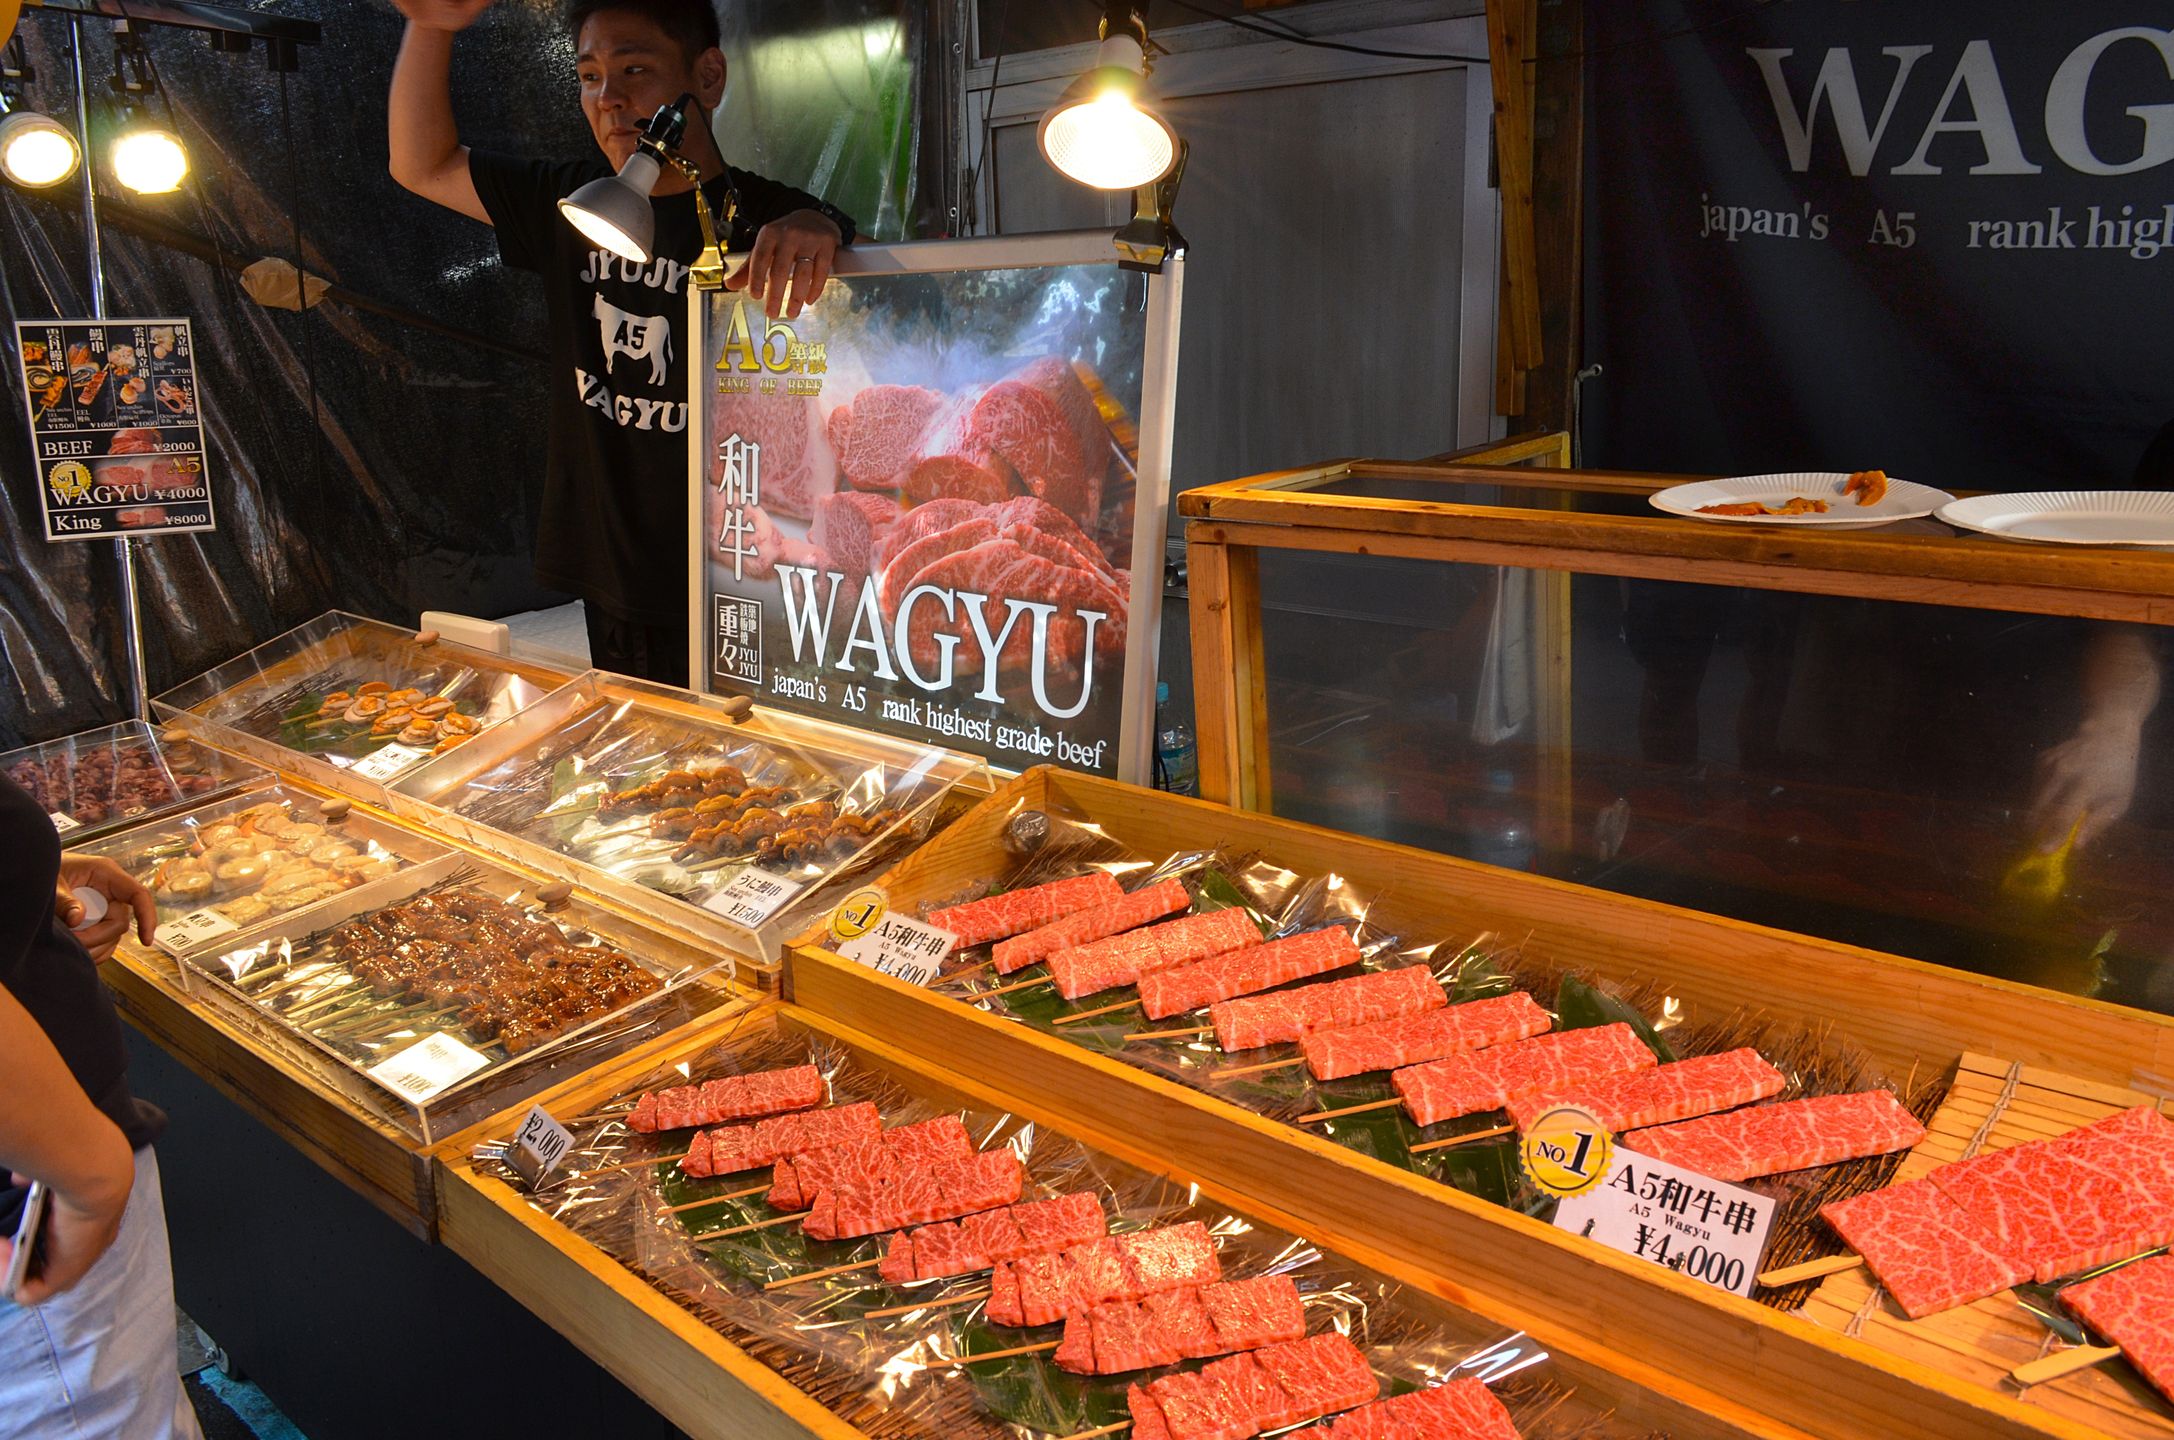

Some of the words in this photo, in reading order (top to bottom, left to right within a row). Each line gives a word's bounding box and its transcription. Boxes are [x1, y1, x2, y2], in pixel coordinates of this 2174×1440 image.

[1701, 193, 1829, 242] japan's
[1869, 208, 1916, 248] A5
[1967, 207, 2075, 250] rank
[614, 320, 648, 350] A5
[718, 377, 750, 394] KING
[760, 378, 777, 395] OF
[787, 379, 822, 396] BEEF
[44, 441, 93, 456] BEEF
[153, 442, 196, 453] ¥2000
[168, 457, 201, 474] A5
[51, 484, 150, 506] WAGYU
[154, 487, 206, 499] ¥4000
[718, 433, 760, 581] 和牛
[55, 515, 102, 531] King
[165, 514, 206, 525] ¥8000
[719, 604, 738, 671] 重々
[773, 564, 1106, 719] WAGYU
[739, 647, 757, 663] JYU
[739, 662, 757, 678] JYU
[772, 667, 826, 703] japan's
[842, 684, 866, 712] A5
[882, 699, 921, 725] rank
[926, 702, 992, 743] highest
[996, 726, 1054, 757] grade
[1057, 731, 1106, 768] beef
[728, 902, 765, 923] ¥1500
[523, 1112, 566, 1162] ¥2,000
[1608, 1163, 1757, 1236] A5和牛串
[1629, 1202, 1652, 1219] A5
[1664, 1213, 1711, 1241] Wagyu
